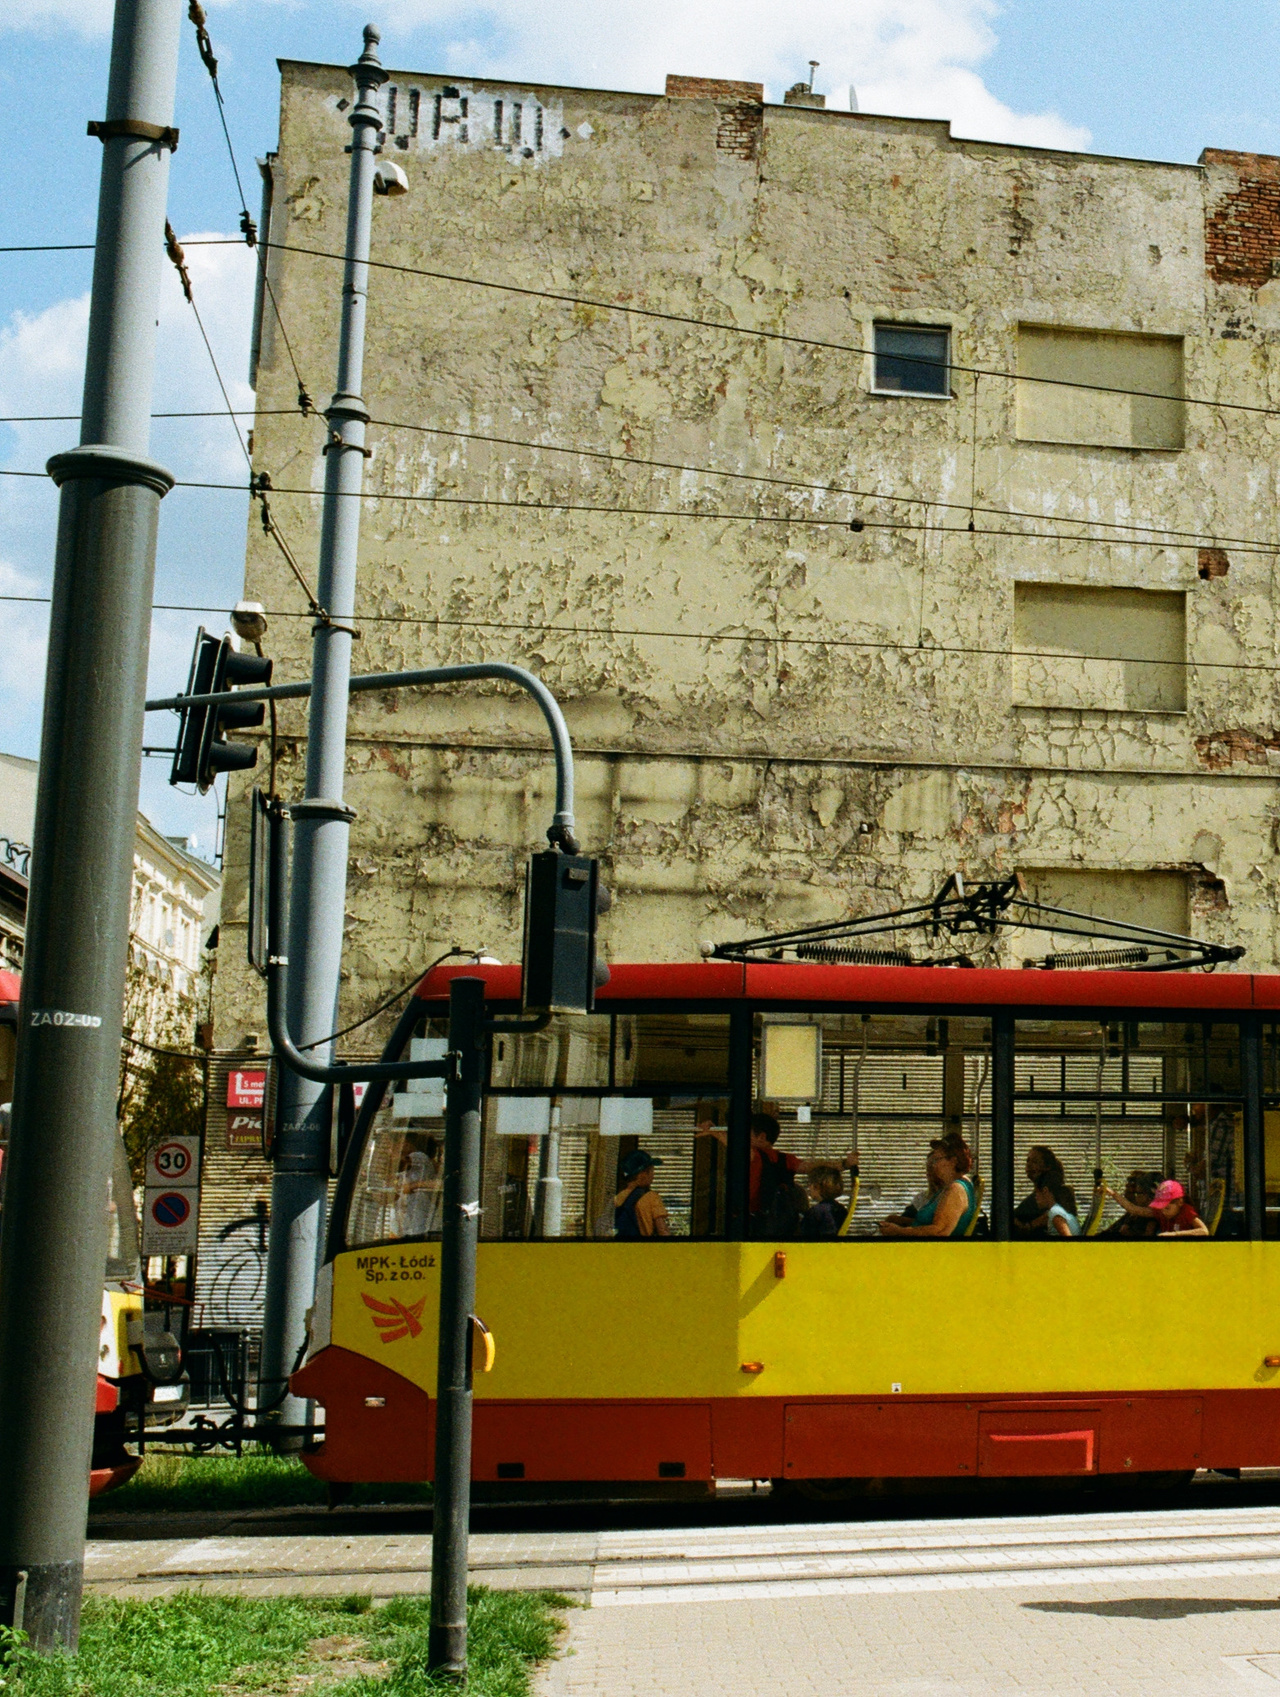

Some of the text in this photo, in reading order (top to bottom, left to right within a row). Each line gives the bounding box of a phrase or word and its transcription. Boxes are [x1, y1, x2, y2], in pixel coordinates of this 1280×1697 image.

[160, 1153, 186, 1169] 30
[366, 1269, 388, 1284] Sp.
[400, 1271, 426, 1280] o.o.
